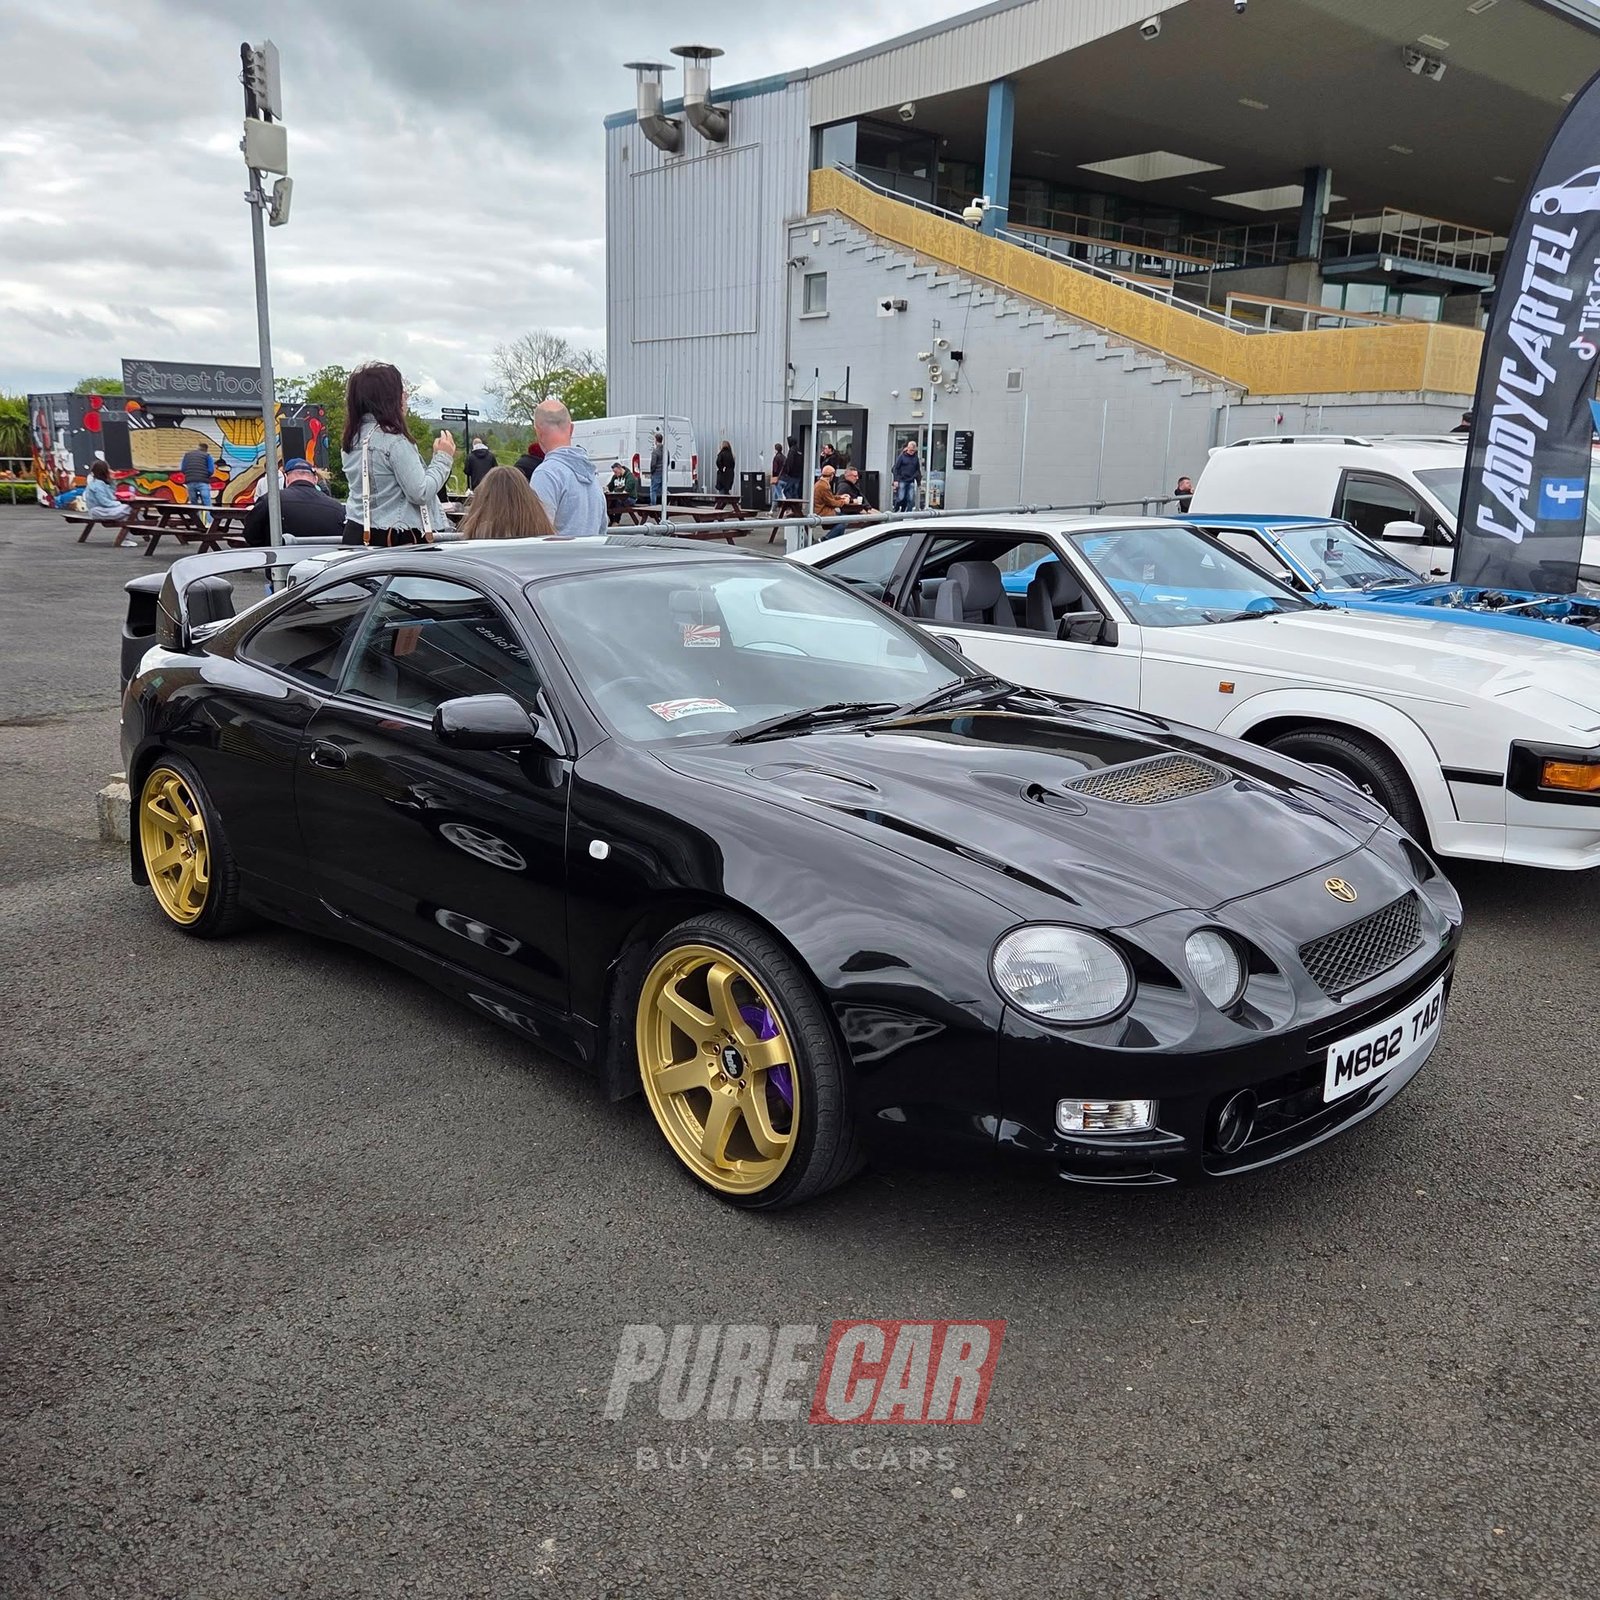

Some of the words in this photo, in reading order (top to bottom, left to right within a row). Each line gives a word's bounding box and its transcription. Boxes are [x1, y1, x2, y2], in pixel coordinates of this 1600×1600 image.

[136, 368, 212, 392] street
[1477, 224, 1578, 544] CADDYCARTEL
[1334, 1025, 1403, 1087] M882
[1411, 993, 1441, 1042] TAB
